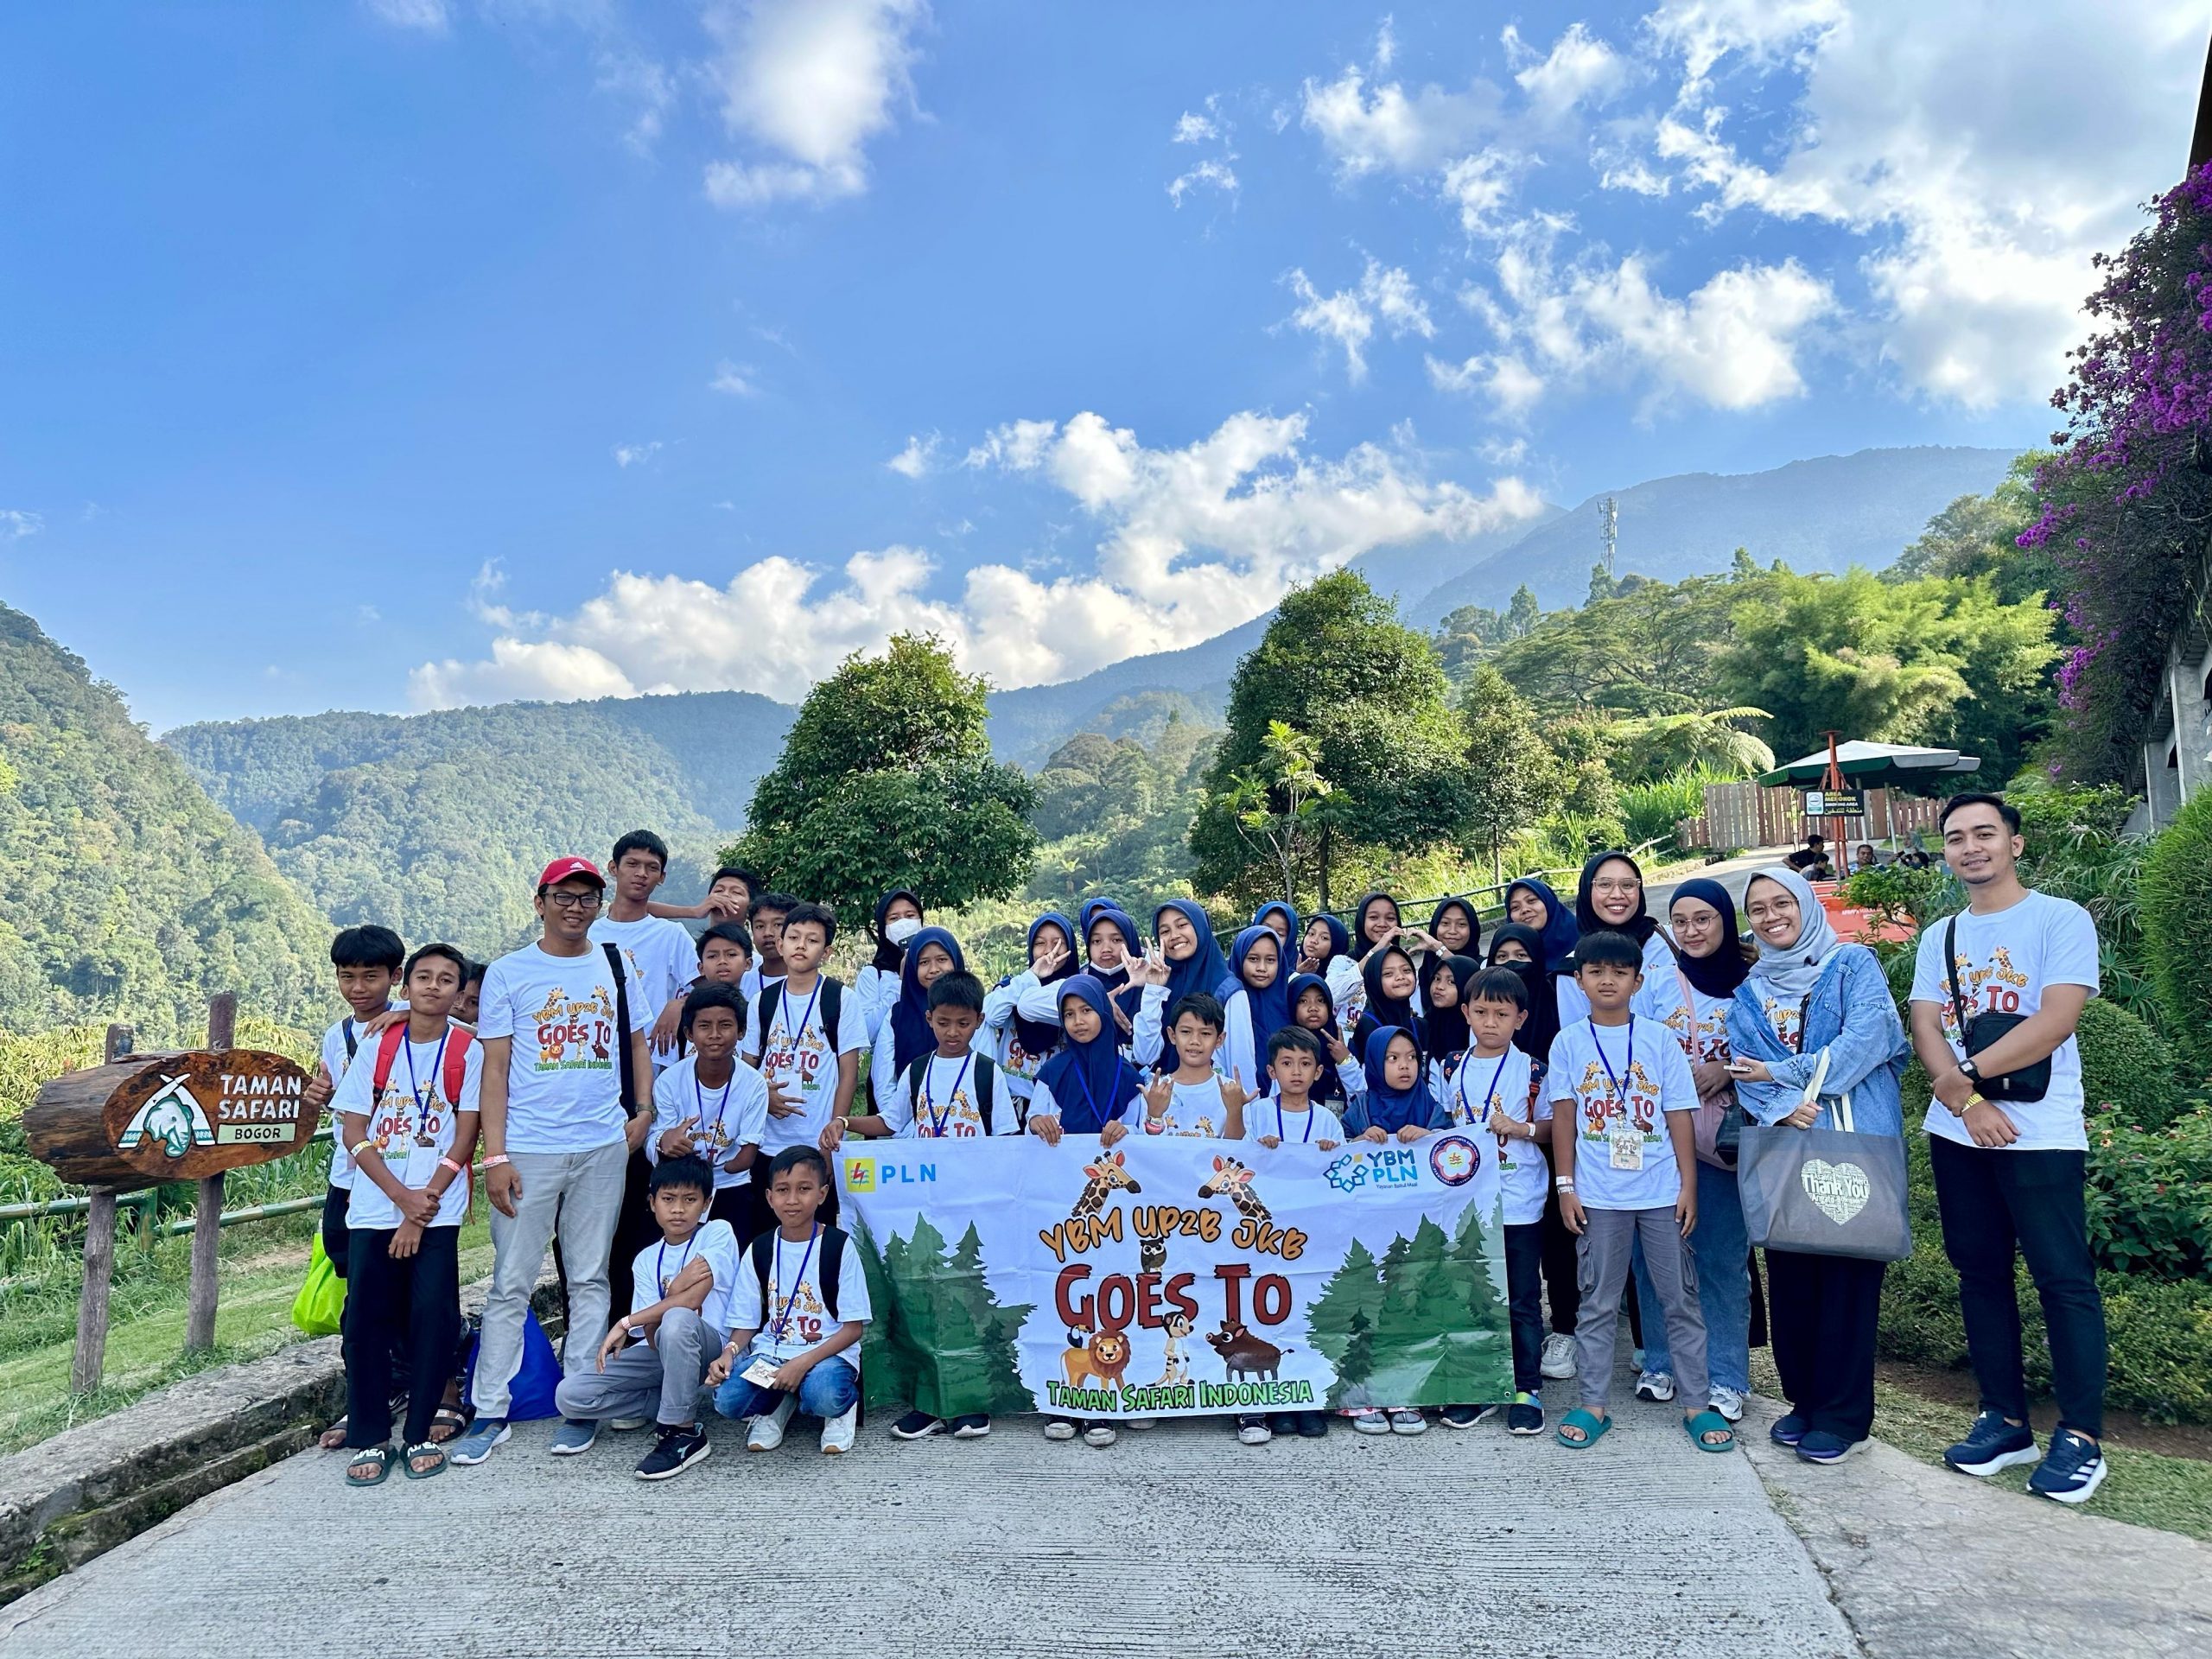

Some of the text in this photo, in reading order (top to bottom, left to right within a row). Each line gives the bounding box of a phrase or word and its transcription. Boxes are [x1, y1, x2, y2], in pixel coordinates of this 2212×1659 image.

[1996, 968, 2029, 988] JKB
[1986, 985, 2019, 1013] TO
[532, 1004, 563, 1026] YBM
[567, 1001, 598, 1014] UP2B
[1774, 1008, 1801, 1022] UP2
[537, 1020, 611, 1045] GOES TO
[560, 1058, 586, 1070] SAFARI
[800, 1051, 819, 1070] TO
[220, 1074, 302, 1095] TAMAN
[1636, 1080, 1660, 1096] JKB
[218, 1098, 300, 1120] SAFARI
[1630, 1095, 1655, 1118] TO
[234, 1128, 281, 1140] BOGOR
[954, 1122, 976, 1137] TO
[1366, 1148, 1415, 1167] YBM
[881, 1163, 937, 1184] PLN
[1372, 1165, 1418, 1183] PLN
[1802, 1173, 1870, 1199] Thank You
[1039, 1205, 1308, 1263] YBM UP2B JKB
[1055, 1263, 1293, 1334] GOES TO
[797, 1315, 822, 1333] TO
[1046, 1380, 1314, 1412] TAMAN SAFARI INDONESIA
